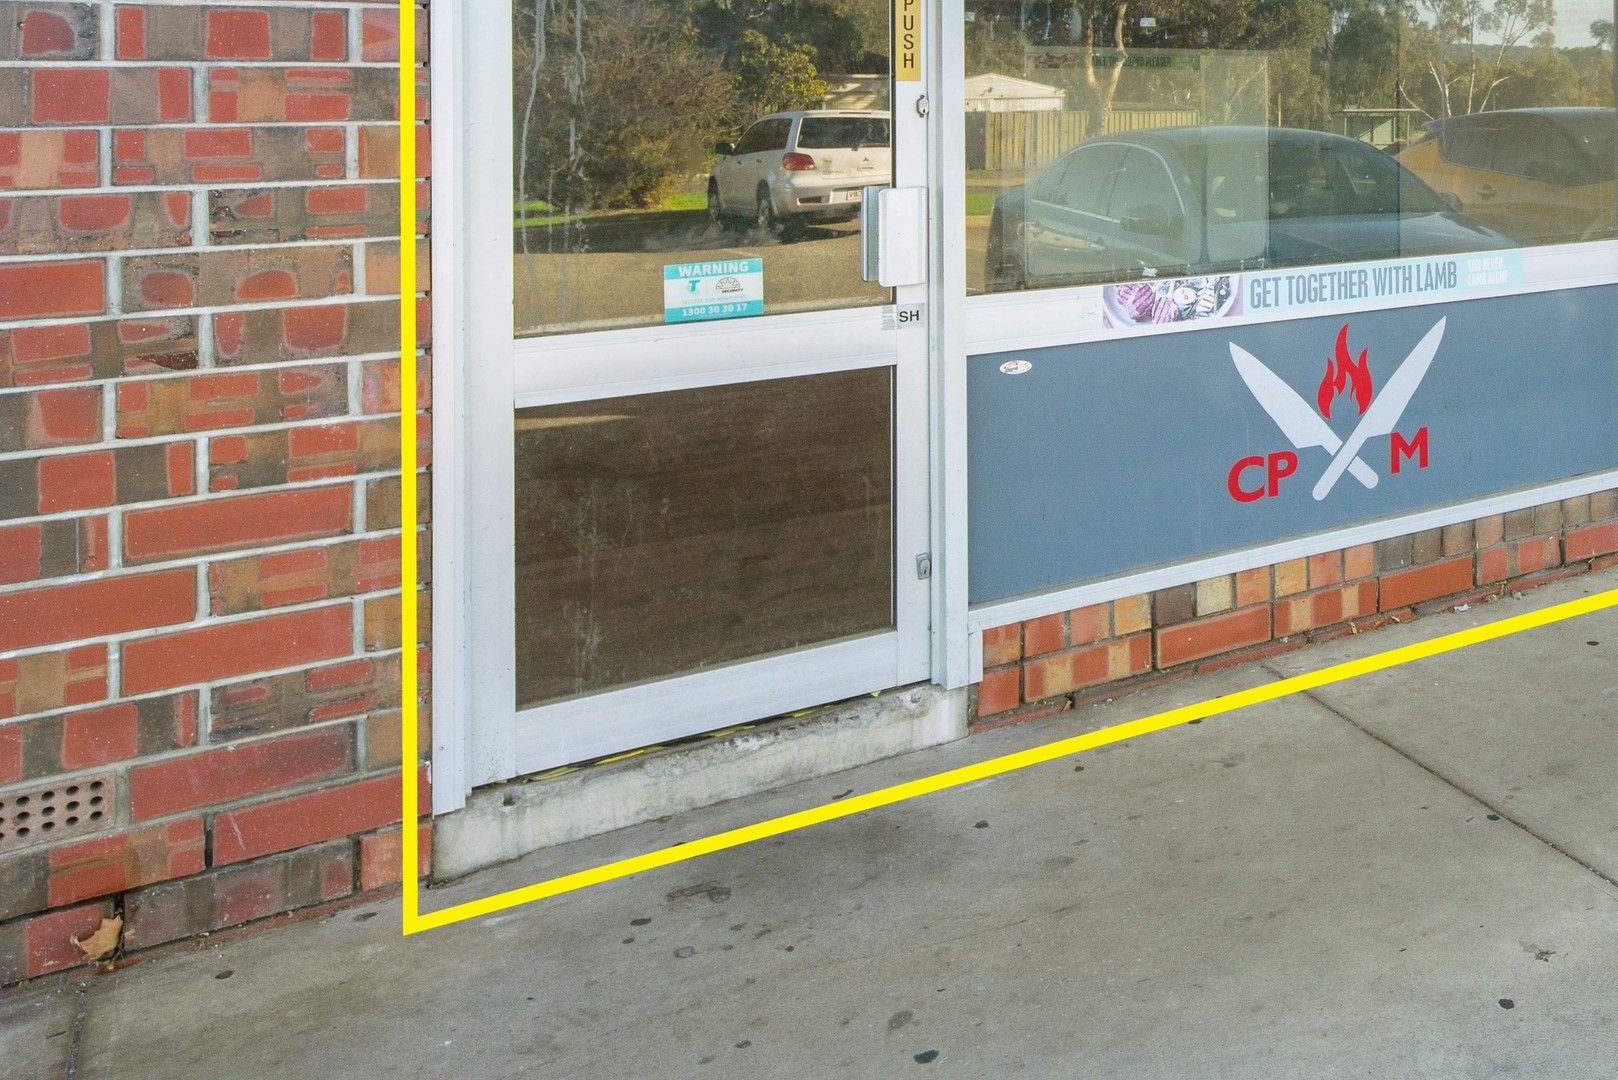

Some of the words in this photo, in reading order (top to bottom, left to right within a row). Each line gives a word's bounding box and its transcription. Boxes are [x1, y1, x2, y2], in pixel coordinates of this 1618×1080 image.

[679, 261, 749, 277] WARNING
[1250, 276, 1282, 309] GET
[1286, 269, 1368, 305] TOGETHER
[1372, 265, 1412, 297] WITH
[1416, 261, 1457, 292] LAMB
[683, 308, 705, 316] 1300
[722, 305, 734, 313] 30
[736, 303, 748, 311] 17
[899, 310, 920, 323] SH
[1227, 451, 1298, 503] CP
[1390, 427, 1430, 474] M
